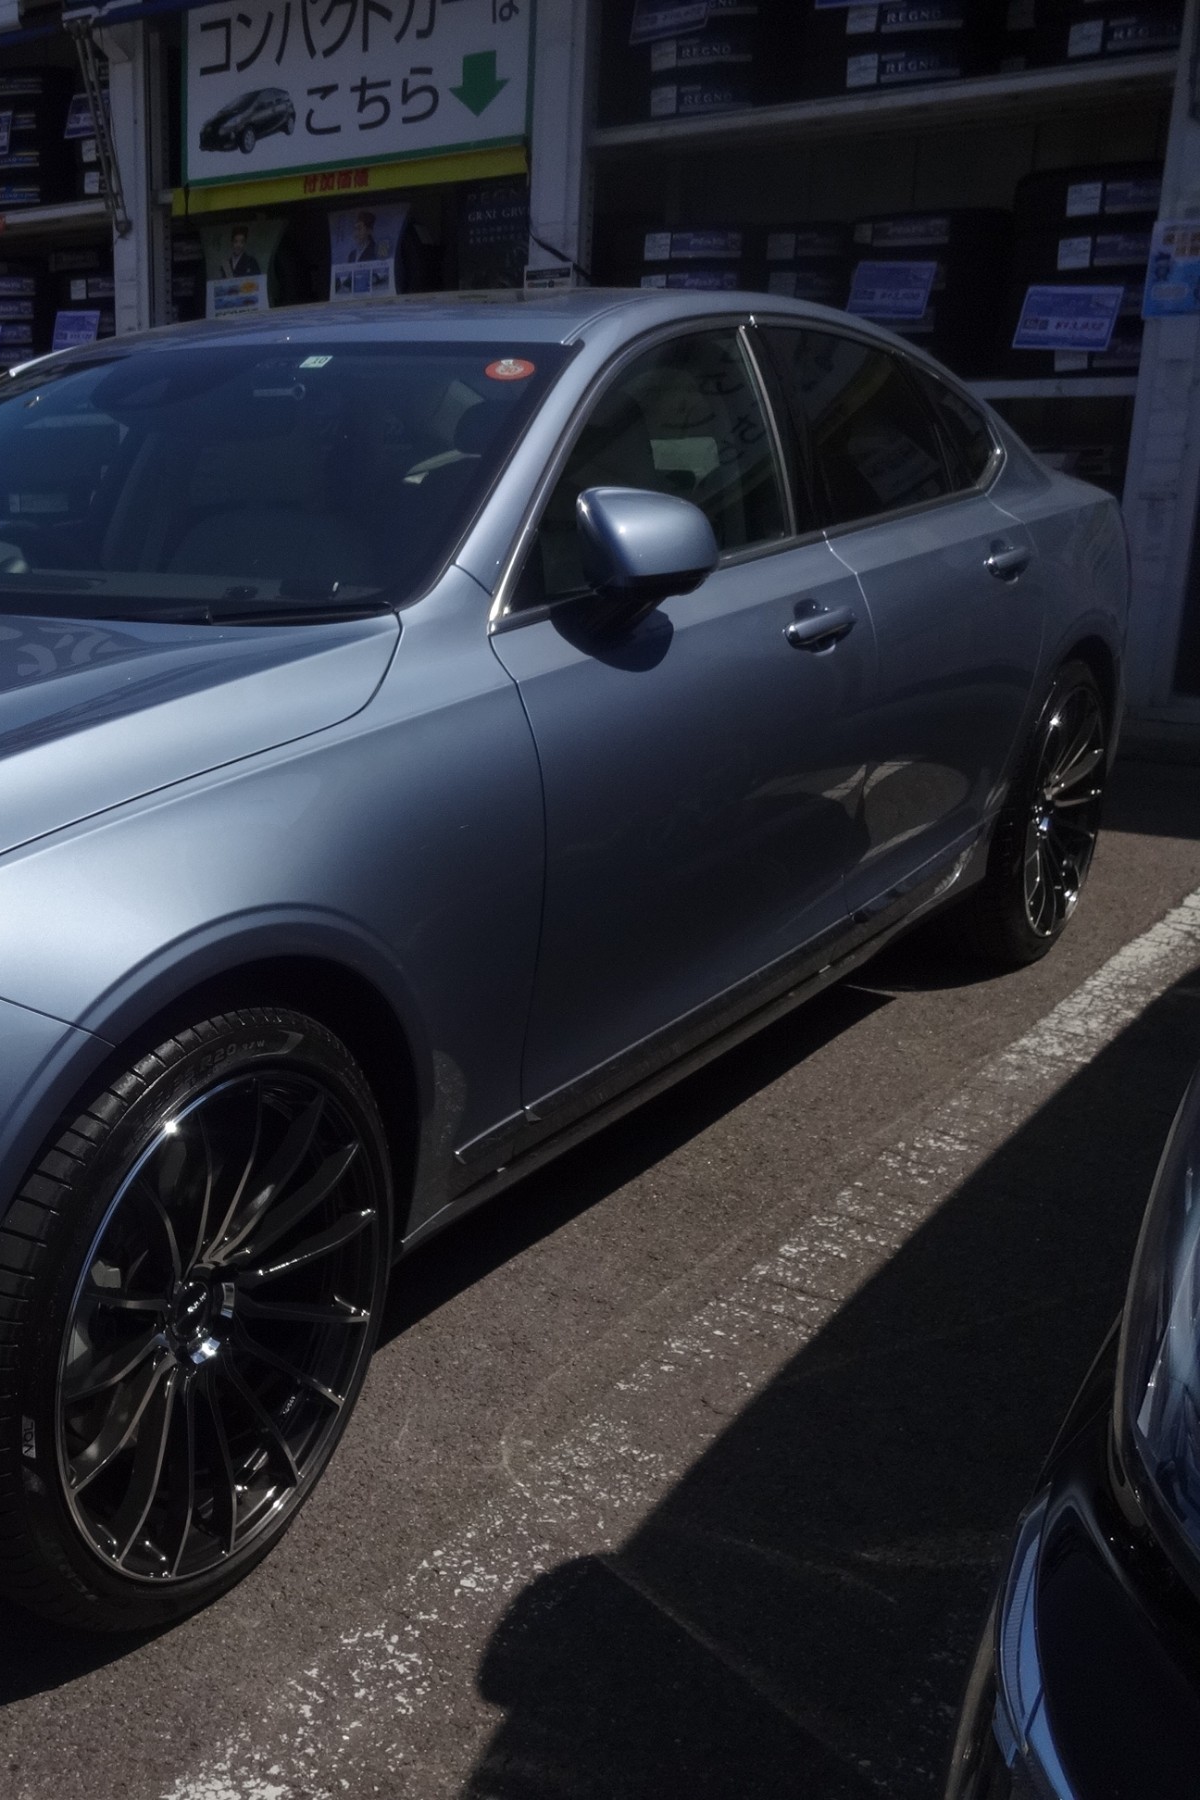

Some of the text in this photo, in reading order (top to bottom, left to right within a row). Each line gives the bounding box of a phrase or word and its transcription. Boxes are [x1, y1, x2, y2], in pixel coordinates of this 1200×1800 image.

[306, 67, 440, 135] こちら
[23, 1421, 35, 1454] VOL
